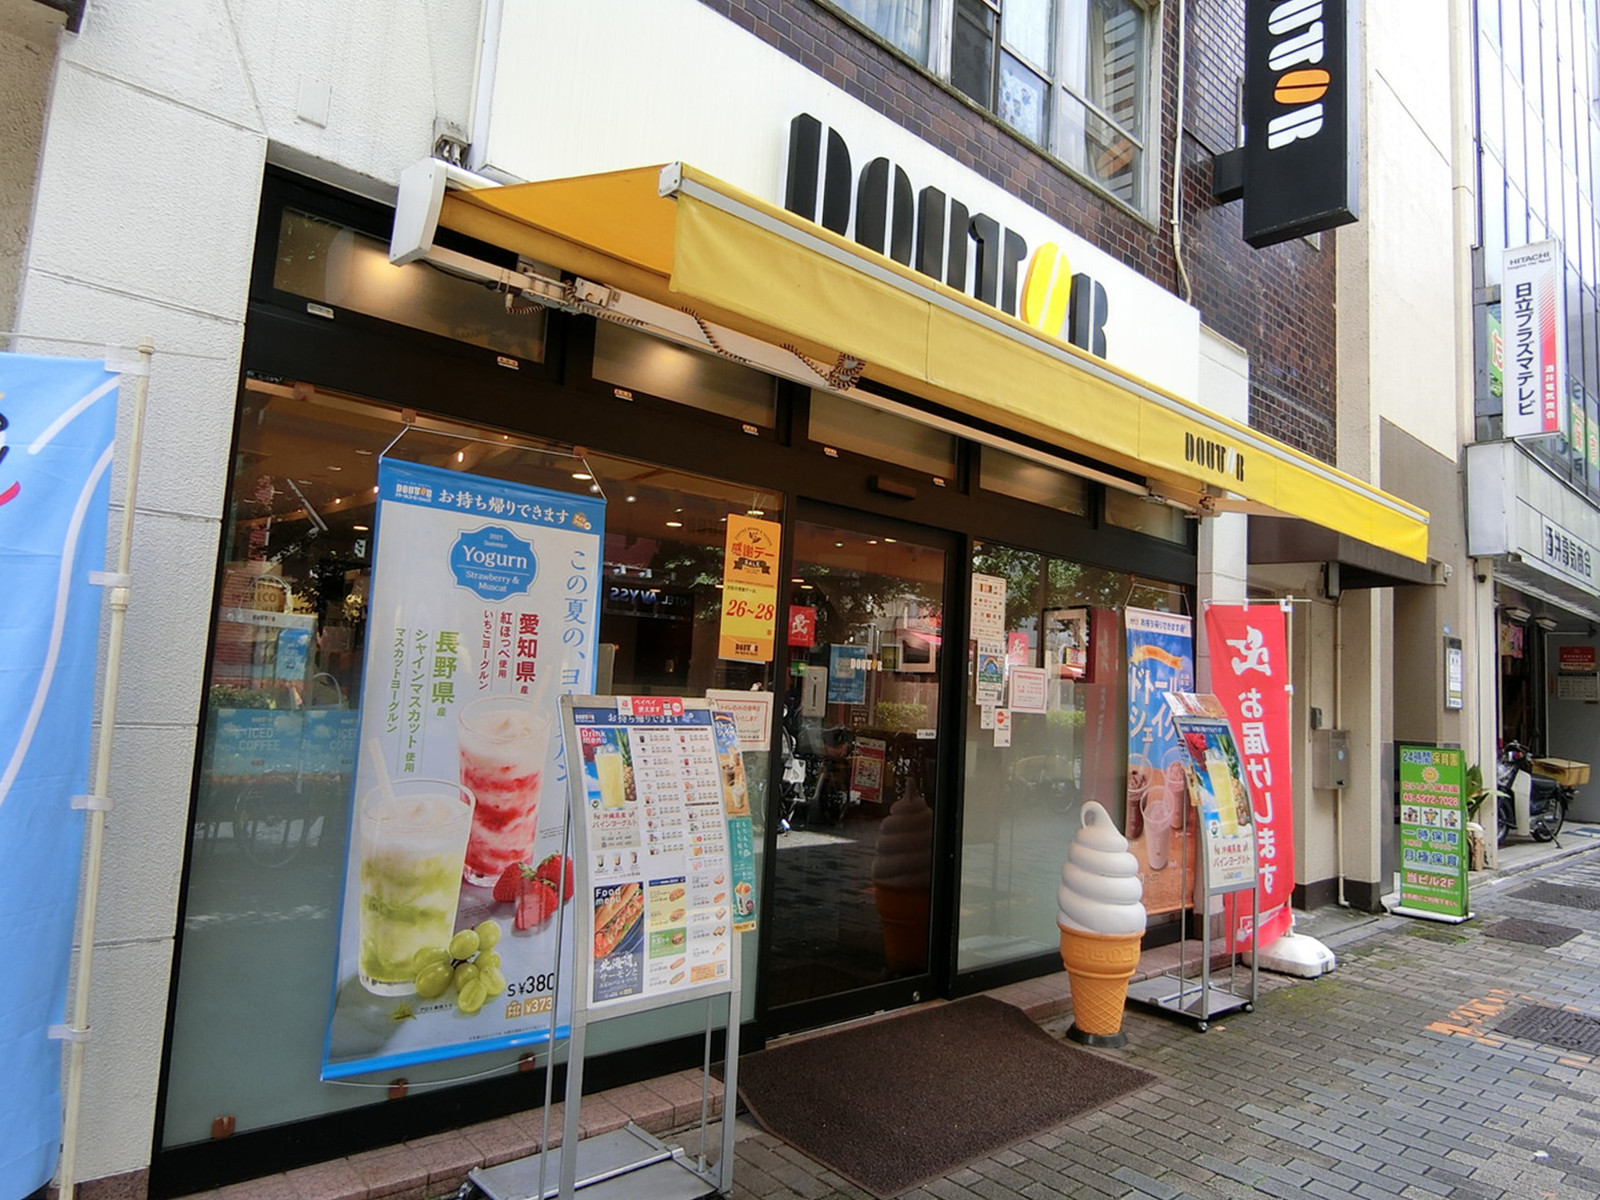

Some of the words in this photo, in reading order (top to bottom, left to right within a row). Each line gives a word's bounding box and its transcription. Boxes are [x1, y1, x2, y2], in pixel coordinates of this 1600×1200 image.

[784, 112, 1108, 359] DOUTOR
[1510, 252, 1550, 265] HITACHI
[1515, 281, 1536, 417] 日立プラズマテレビ
[1185, 432, 1244, 482] DOUTOR
[439, 489, 570, 524] お持ち帰りできます
[462, 545, 528, 569] Yogurn
[730, 541, 775, 559] 感謝デー
[744, 558, 761, 568] SALE
[465, 570, 511, 585] Strawberry
[511, 575, 520, 585] &
[478, 582, 508, 593] Muscat
[479, 610, 495, 690] いちごヨーグルン
[498, 612, 513, 679] 紅ほっぺ使用
[515, 613, 540, 695] 愛知県産
[431, 631, 460, 717] 長野県産
[850, 658, 883, 672] DOUTOR
[387, 628, 407, 733] マスカットヨーグルン
[404, 629, 429, 773] シャインマスカット使用
[582, 729, 607, 737] Drink
[1403, 828, 1458, 845] 一時保育
[1403, 849, 1458, 868] 月極保育
[1406, 872, 1456, 889] 当ビル2F
[596, 888, 621, 897] Food
[596, 896, 621, 905] menu
[507, 983, 516, 997] S
[518, 972, 555, 995] ¥380
